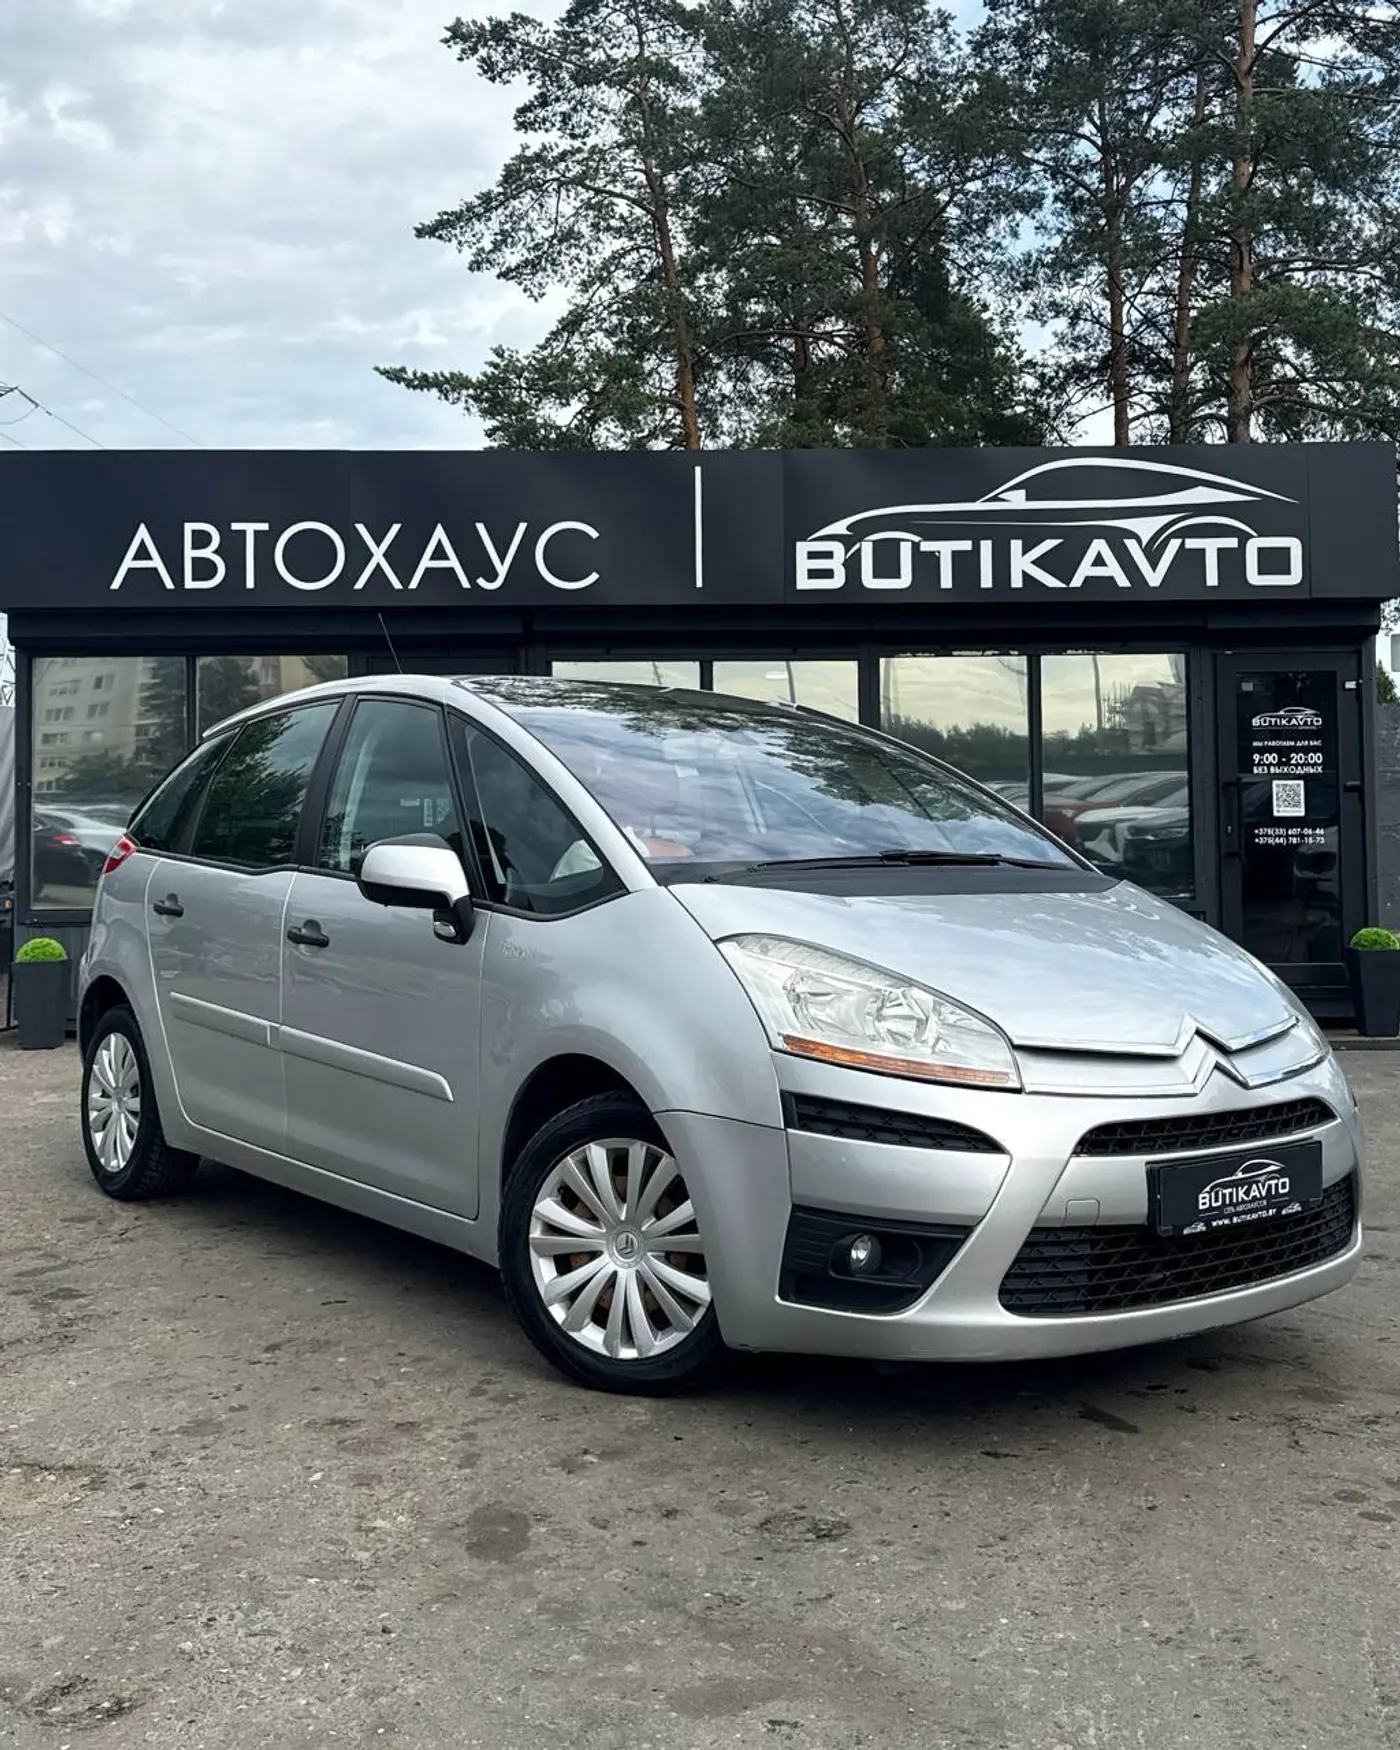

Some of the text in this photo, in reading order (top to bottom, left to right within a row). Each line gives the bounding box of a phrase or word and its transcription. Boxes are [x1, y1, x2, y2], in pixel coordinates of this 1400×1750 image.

[109, 521, 601, 591] АВТОХАУС
[795, 536, 1304, 590] BUTIKAVTO
[1252, 717, 1323, 726] BUTIKAVTO
[1252, 753, 1279, 764] 9:00
[1290, 753, 1323, 764] 20:00
[1253, 765, 1323, 774] БЕЗ ВЫХОДНЫХ
[1198, 1177, 1290, 1210] BUTIKAVTO
